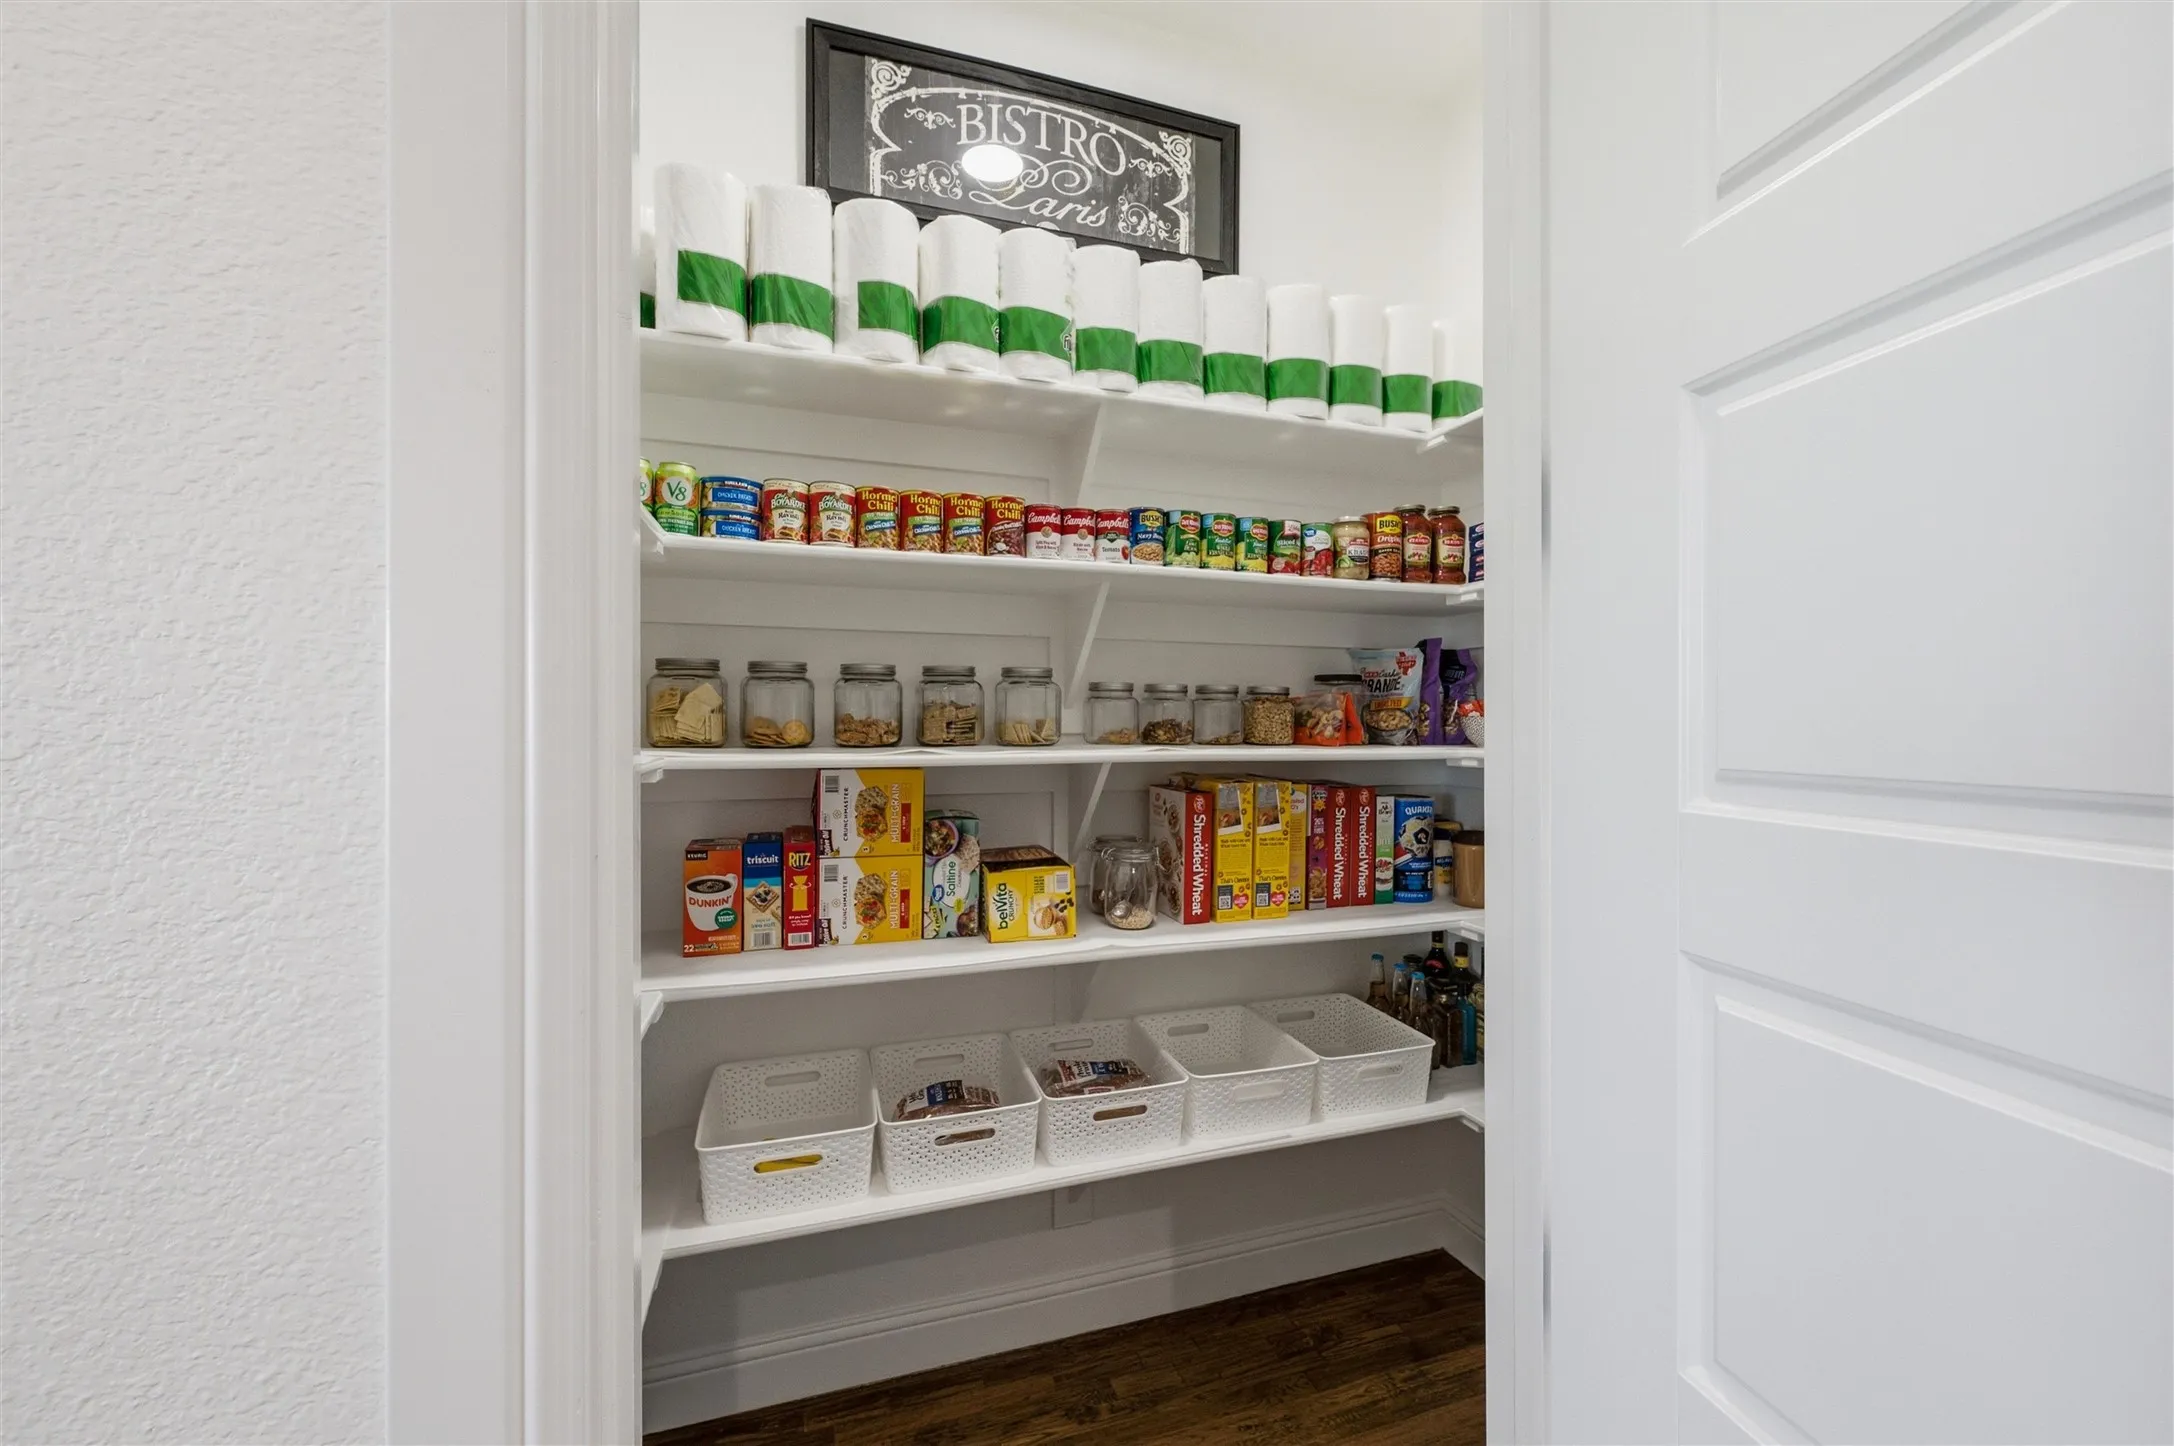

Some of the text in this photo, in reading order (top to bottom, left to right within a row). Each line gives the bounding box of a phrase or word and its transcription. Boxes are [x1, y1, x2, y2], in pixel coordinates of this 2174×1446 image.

[956, 103, 1128, 177] BISTRO
[666, 480, 688, 502] V8
[910, 494, 941, 506] Horm
[867, 500, 894, 512] Chili
[956, 505, 981, 517] Chili
[996, 508, 1021, 520] Chili
[890, 783, 900, 843] MULTI-GRAIN
[746, 853, 780, 865] triscuit
[788, 852, 811, 867] RITZ
[1192, 814, 1206, 916] Shredded Wheat
[1333, 807, 1346, 900] Shredded Wheat
[1358, 806, 1371, 898] Shredded Wheat
[946, 861, 956, 897] Saltine
[688, 895, 732, 908] DUNKIN'
[890, 869, 899, 930] MULTI-GRAIN
[992, 882, 1008, 930] belVita
[1007, 889, 1015, 922] CRUNCHY
[683, 944, 695, 953] 22
